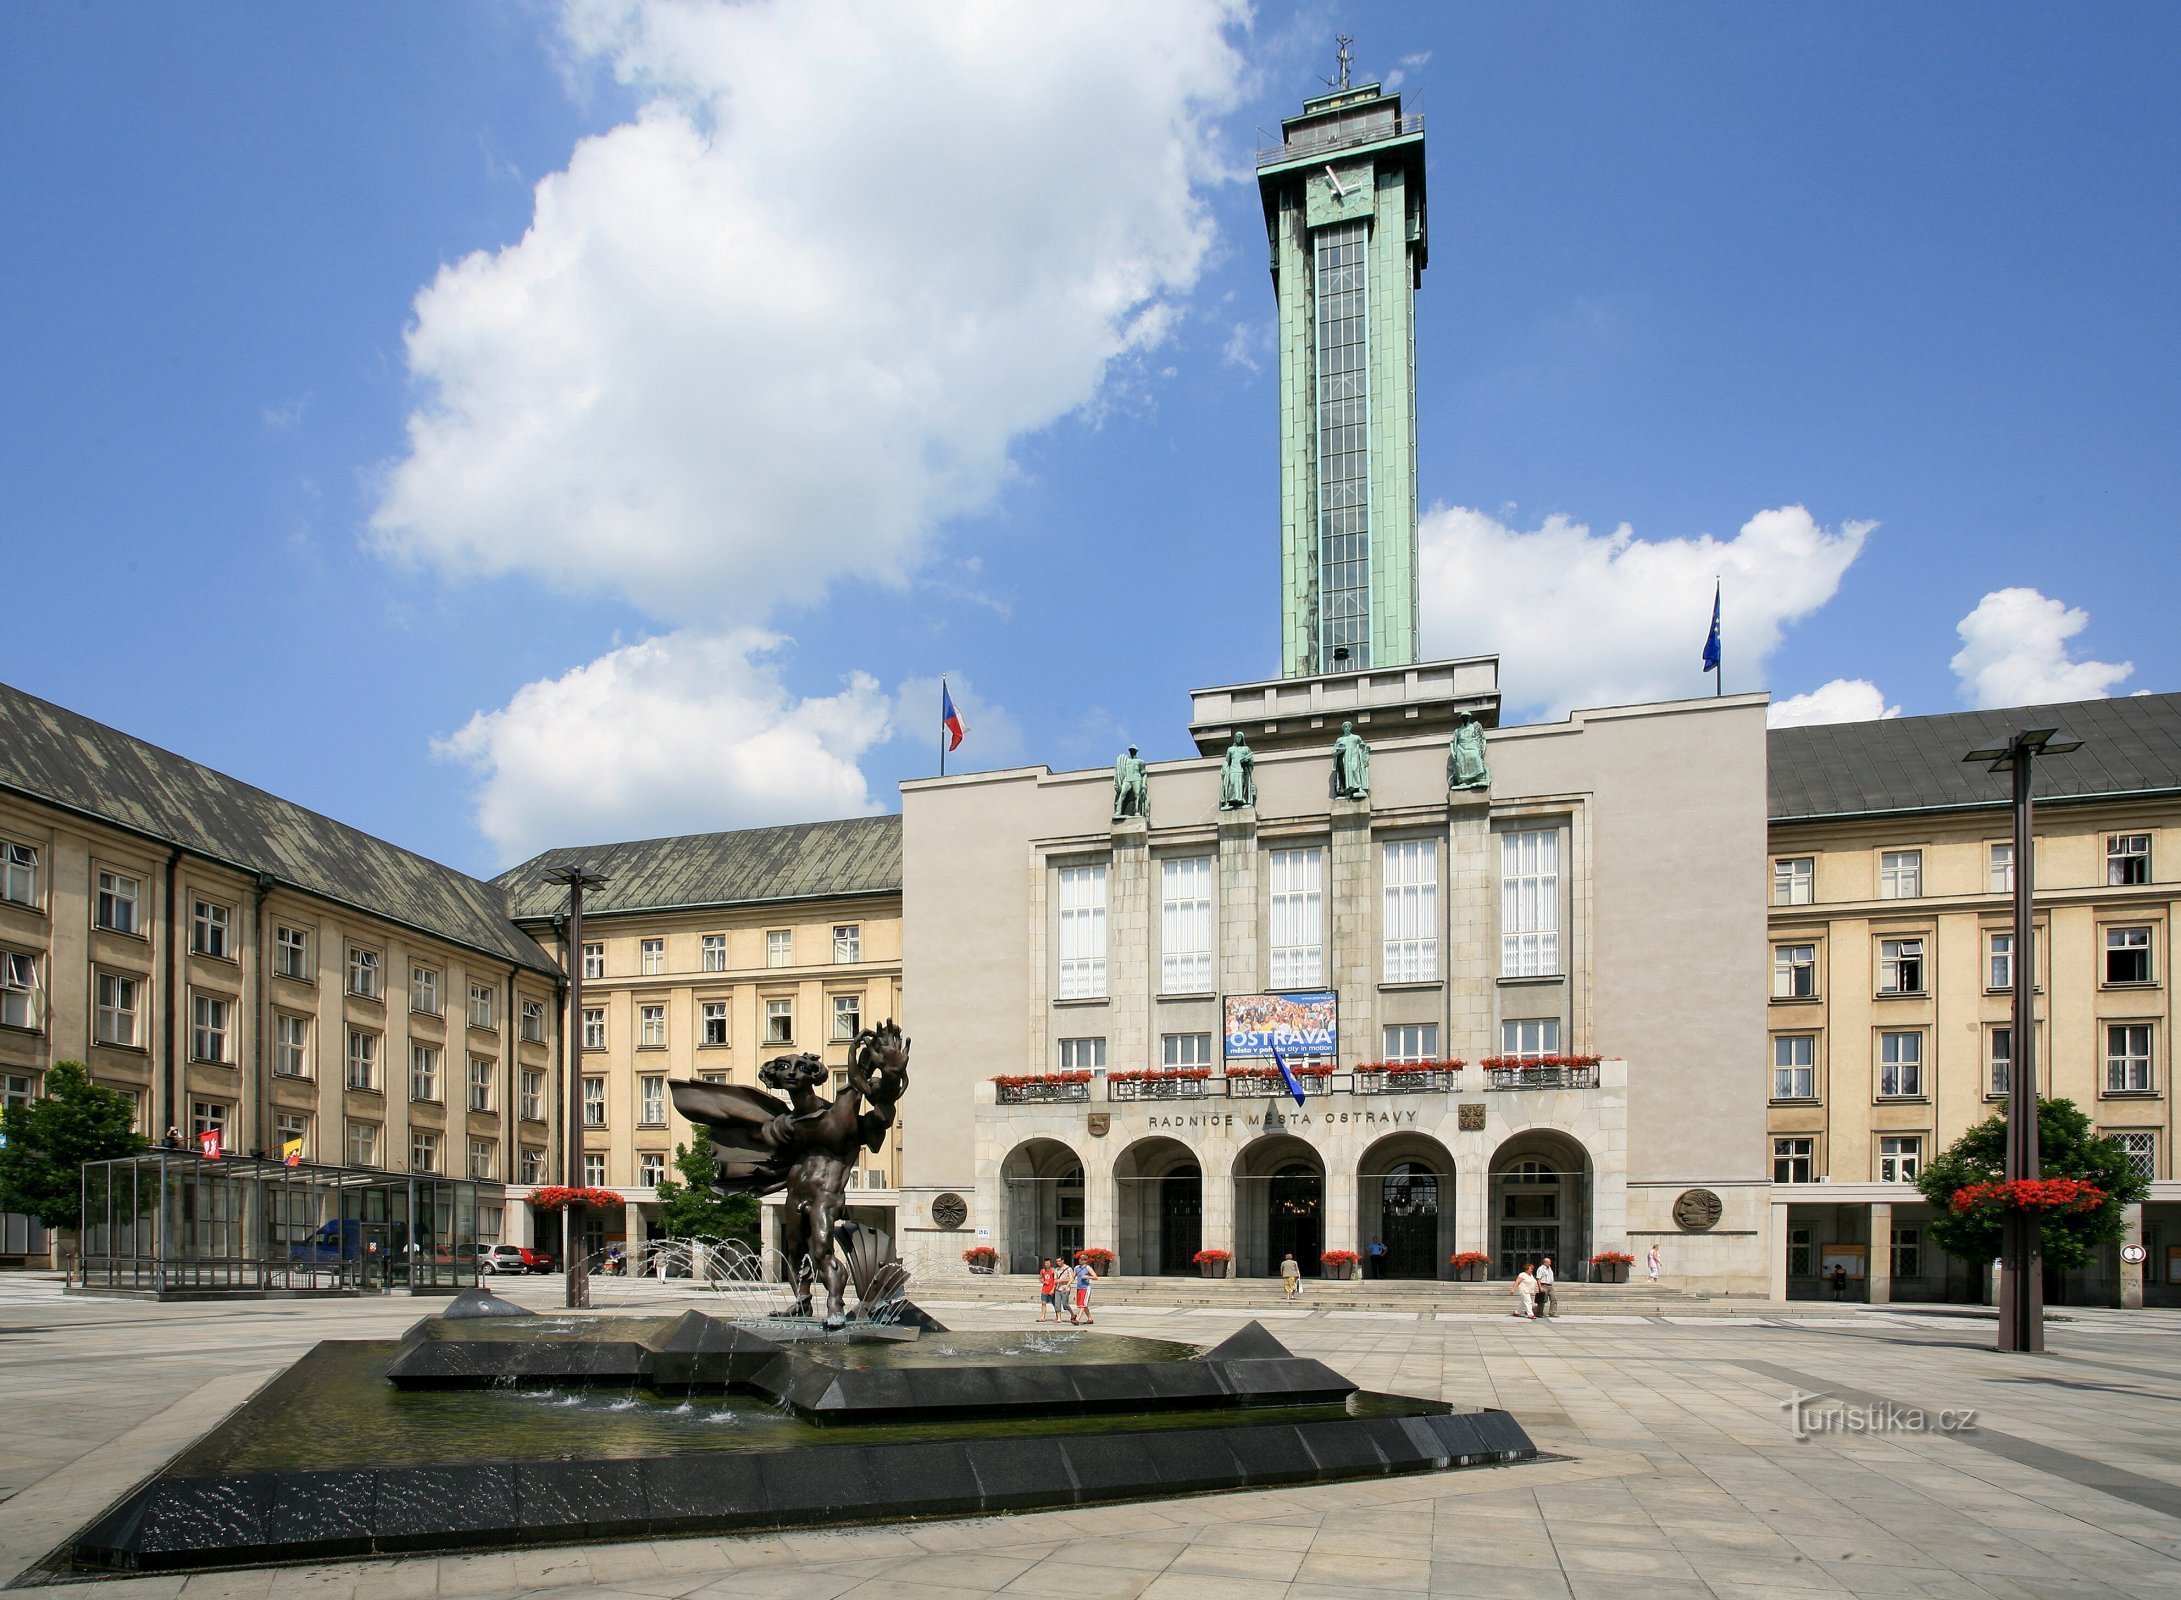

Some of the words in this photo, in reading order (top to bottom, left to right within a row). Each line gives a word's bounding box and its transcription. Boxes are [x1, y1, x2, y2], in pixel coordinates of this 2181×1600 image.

[1230, 1029, 1332, 1046] OSTRAVA
[1259, 1046, 1286, 1054] pohbu
[1287, 1045, 1299, 1053] city
[1148, 1114, 1233, 1127] RADNICE
[1248, 1111, 1312, 1126] MĚSTA
[1325, 1110, 1417, 1124] OSTRAVY
